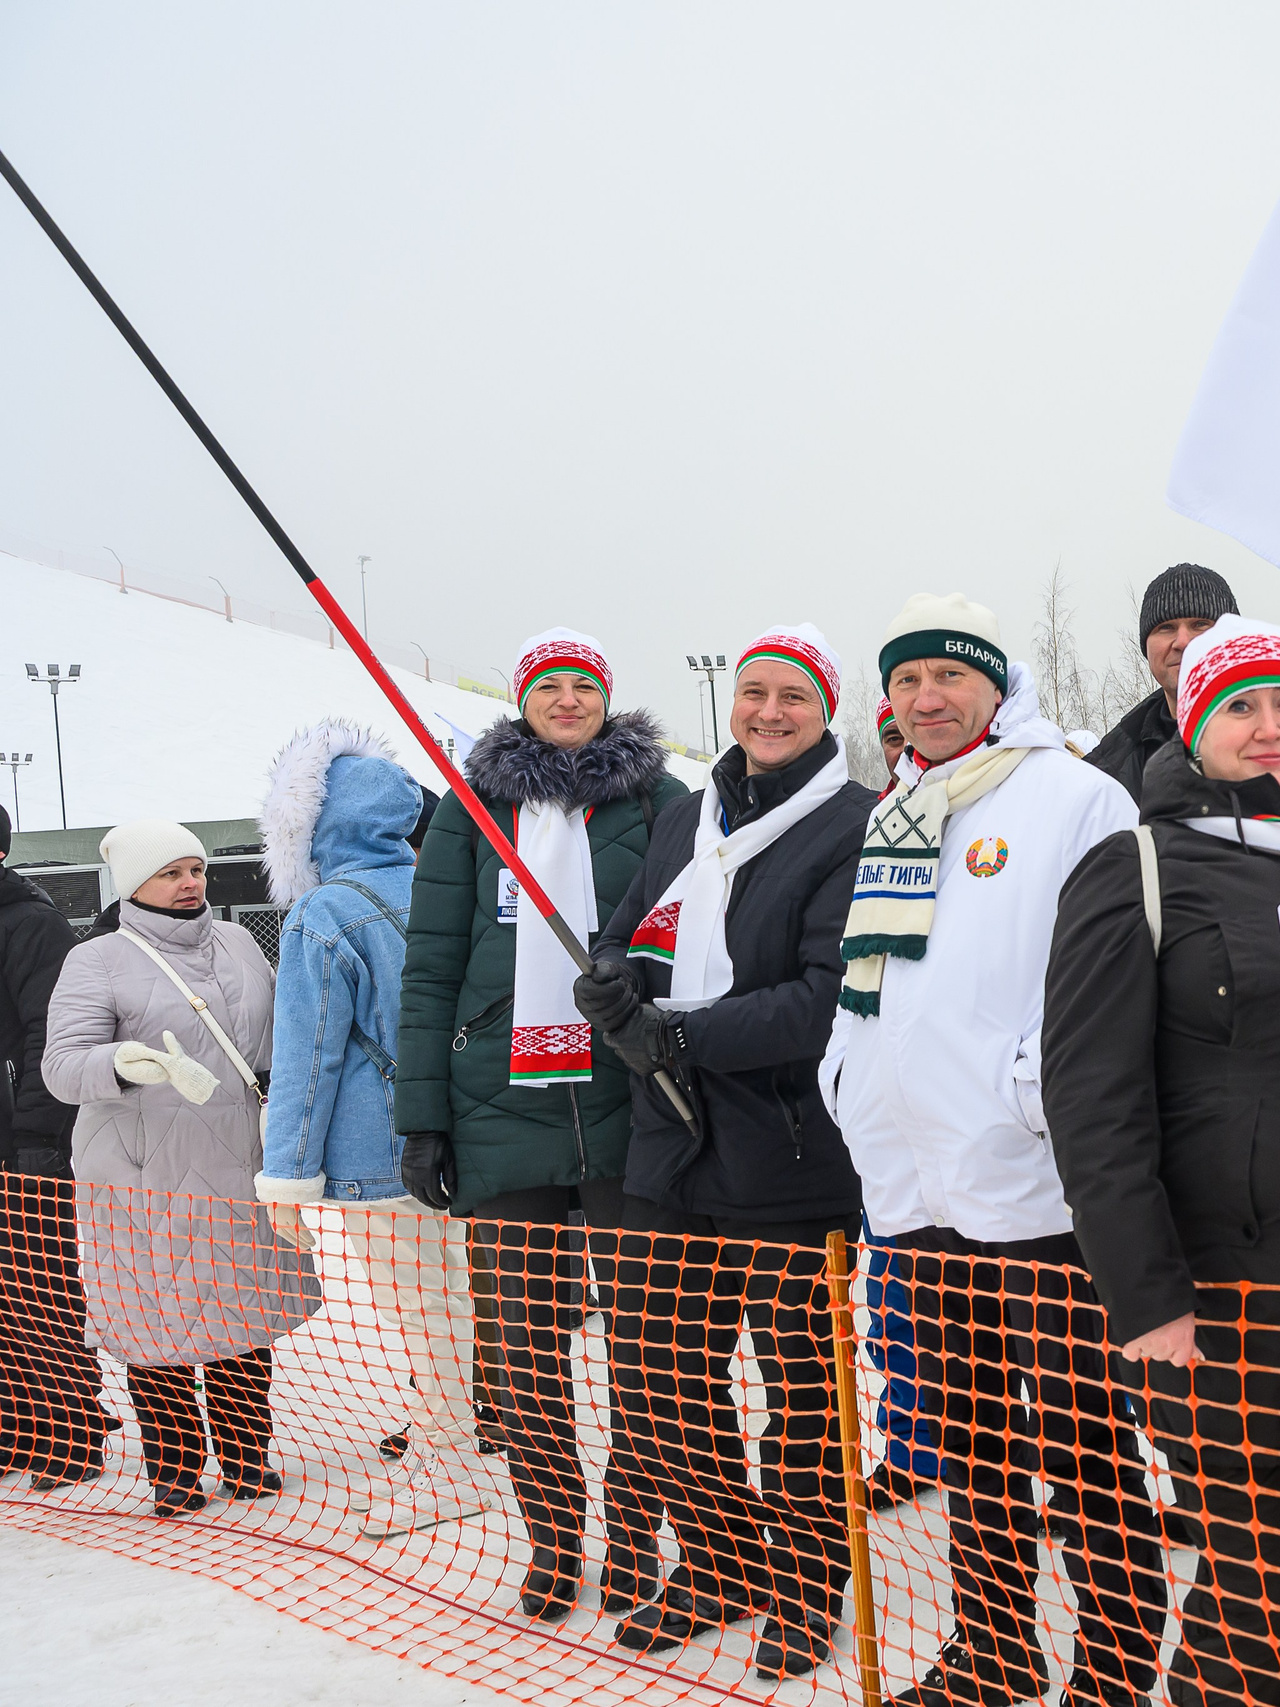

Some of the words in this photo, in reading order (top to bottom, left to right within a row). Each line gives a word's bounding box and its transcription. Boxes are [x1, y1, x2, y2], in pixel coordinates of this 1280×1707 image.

[945, 640, 1005, 675] БЕЛАРУСЬ
[856, 864, 886, 885] ЕЛЫЕ
[889, 865, 933, 886] ТИГРЫ
[501, 907, 518, 916] ЛЮД
